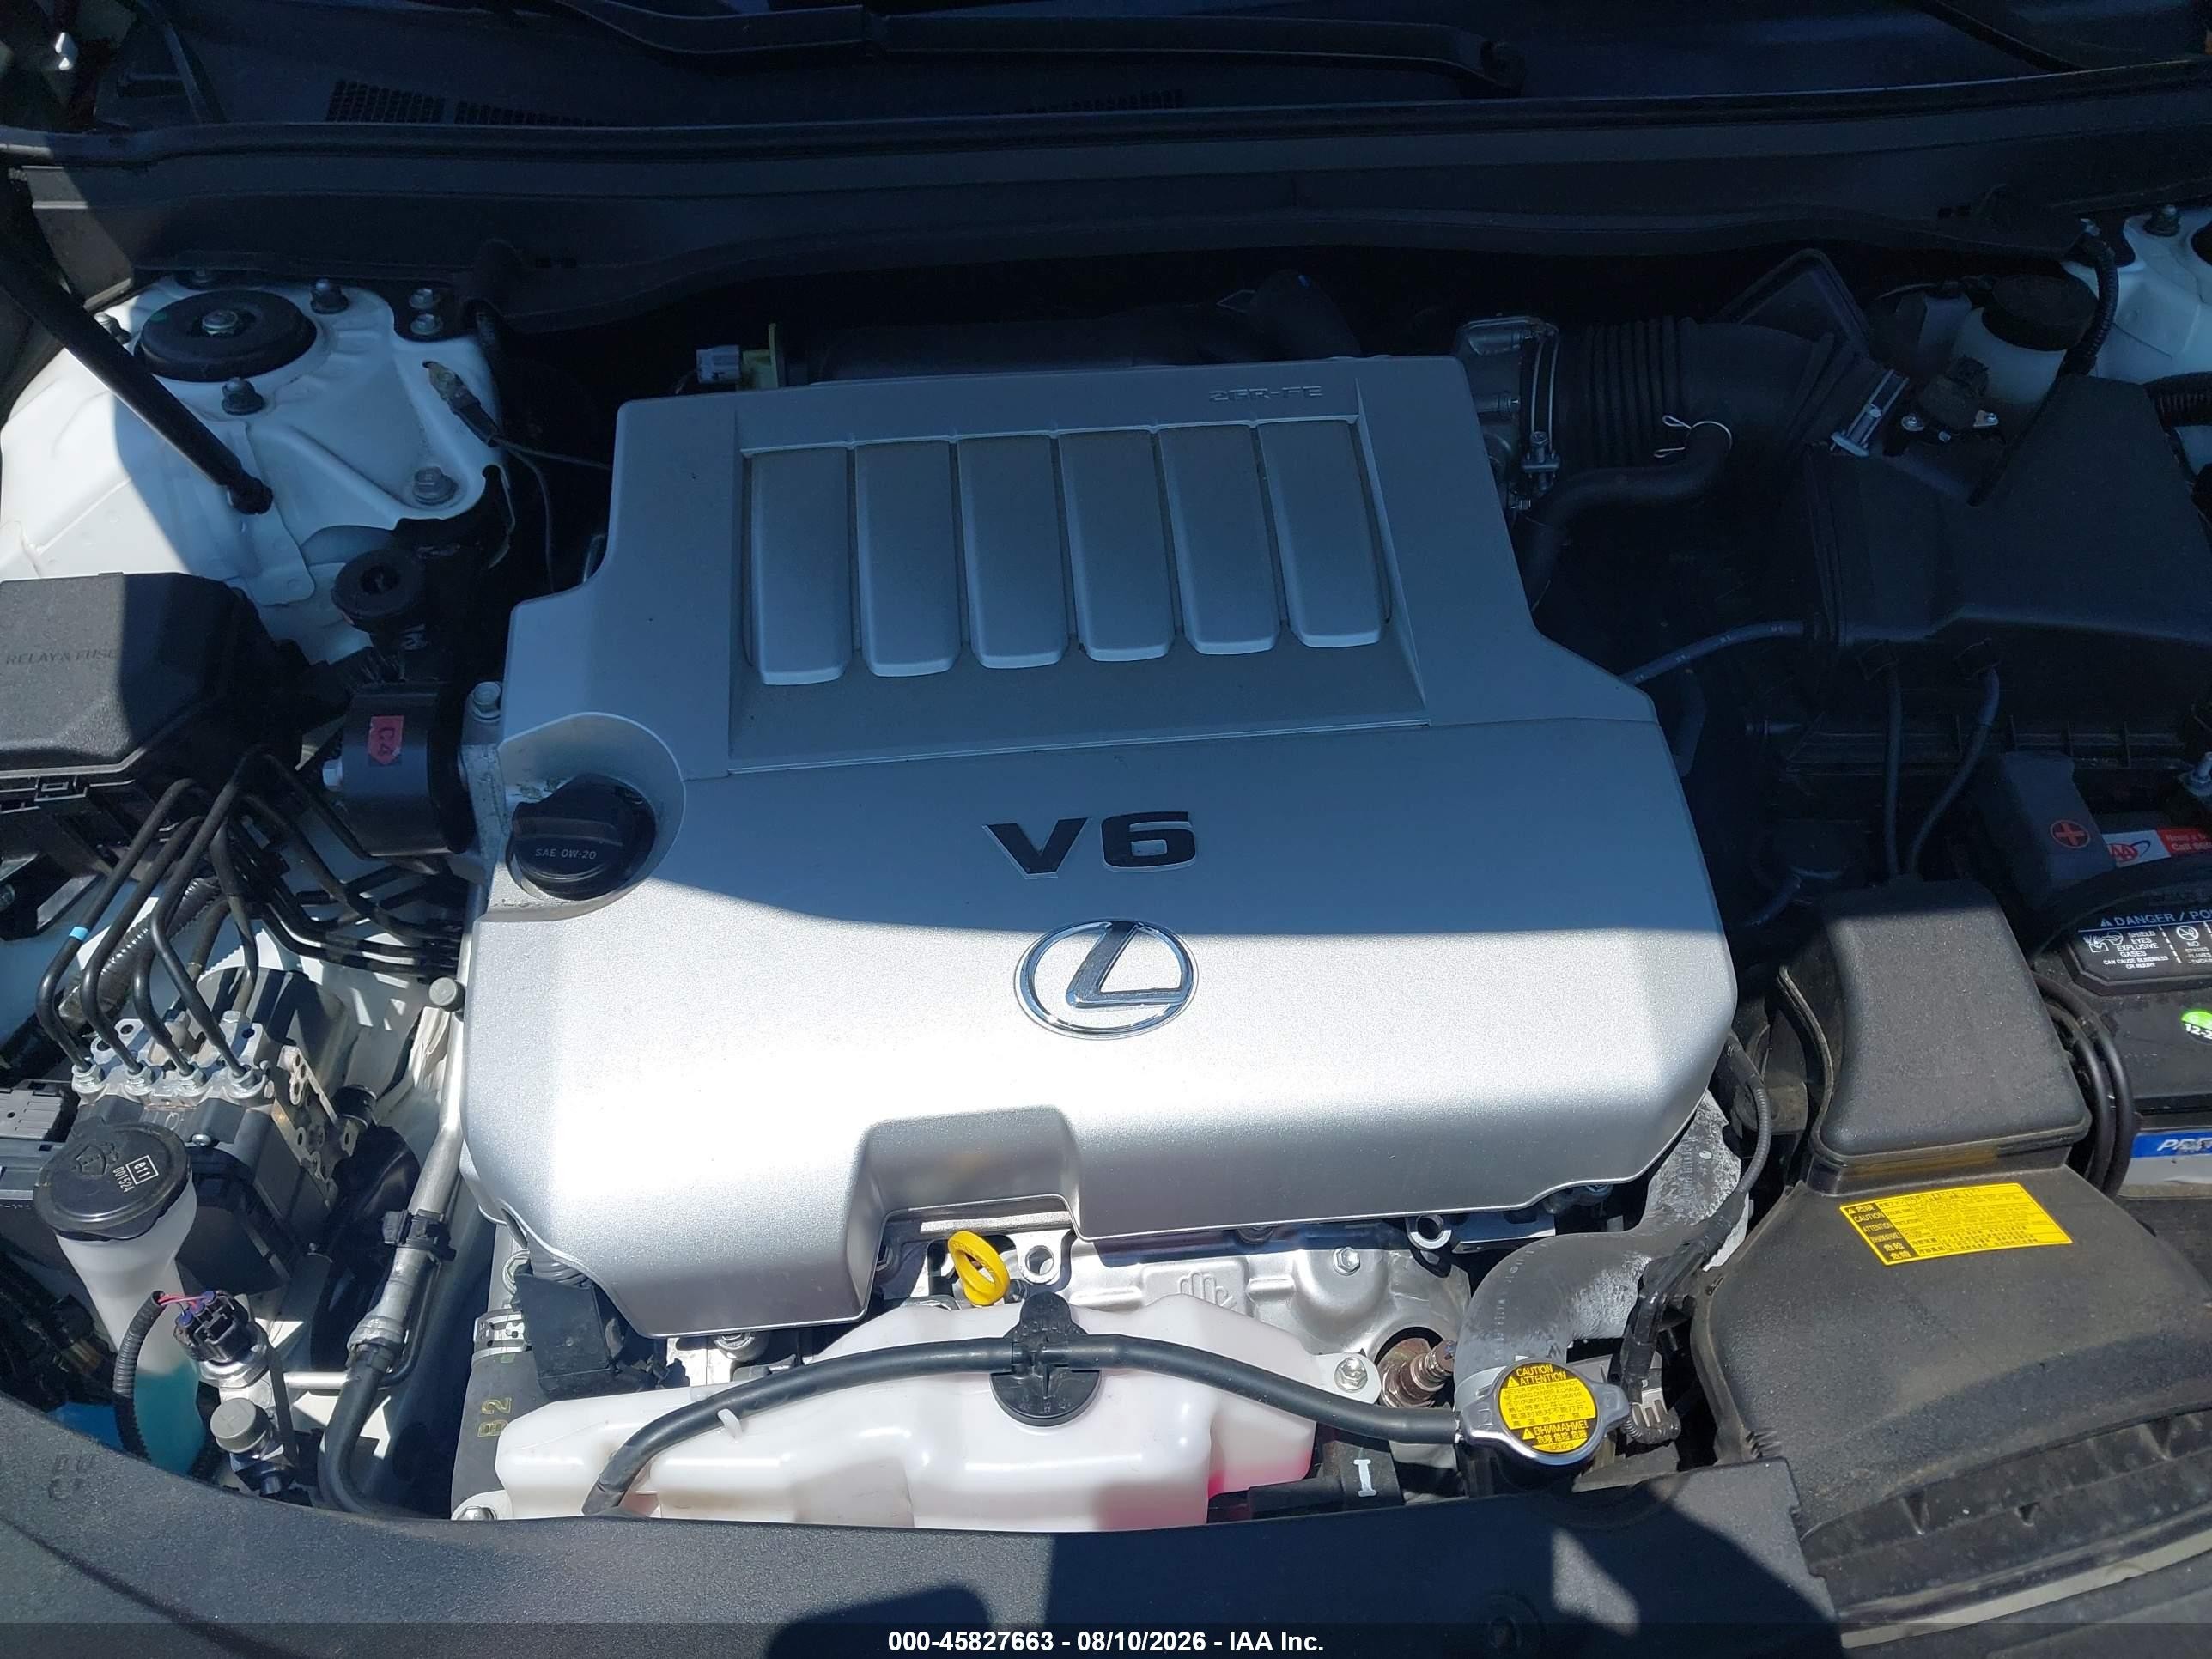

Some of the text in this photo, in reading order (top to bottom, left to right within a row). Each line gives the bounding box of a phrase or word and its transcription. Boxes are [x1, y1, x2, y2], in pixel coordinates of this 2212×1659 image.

[983, 810, 1198, 879] V6
[535, 848, 598, 860] SAE 0W-20
[2114, 913, 2176, 926] DANGER
[2190, 909, 2212, 920] PO
[134, 1162, 151, 1179] e11
[112, 1166, 136, 1193] 001524
[1854, 1212, 1886, 1223] CAUTION
[1516, 1364, 1553, 1377] CAUTION
[1520, 1371, 1567, 1385] ATTENTION
[477, 1397, 513, 1438] B2
[1533, 1419, 1589, 1436] ВНИМАНИЕ!
